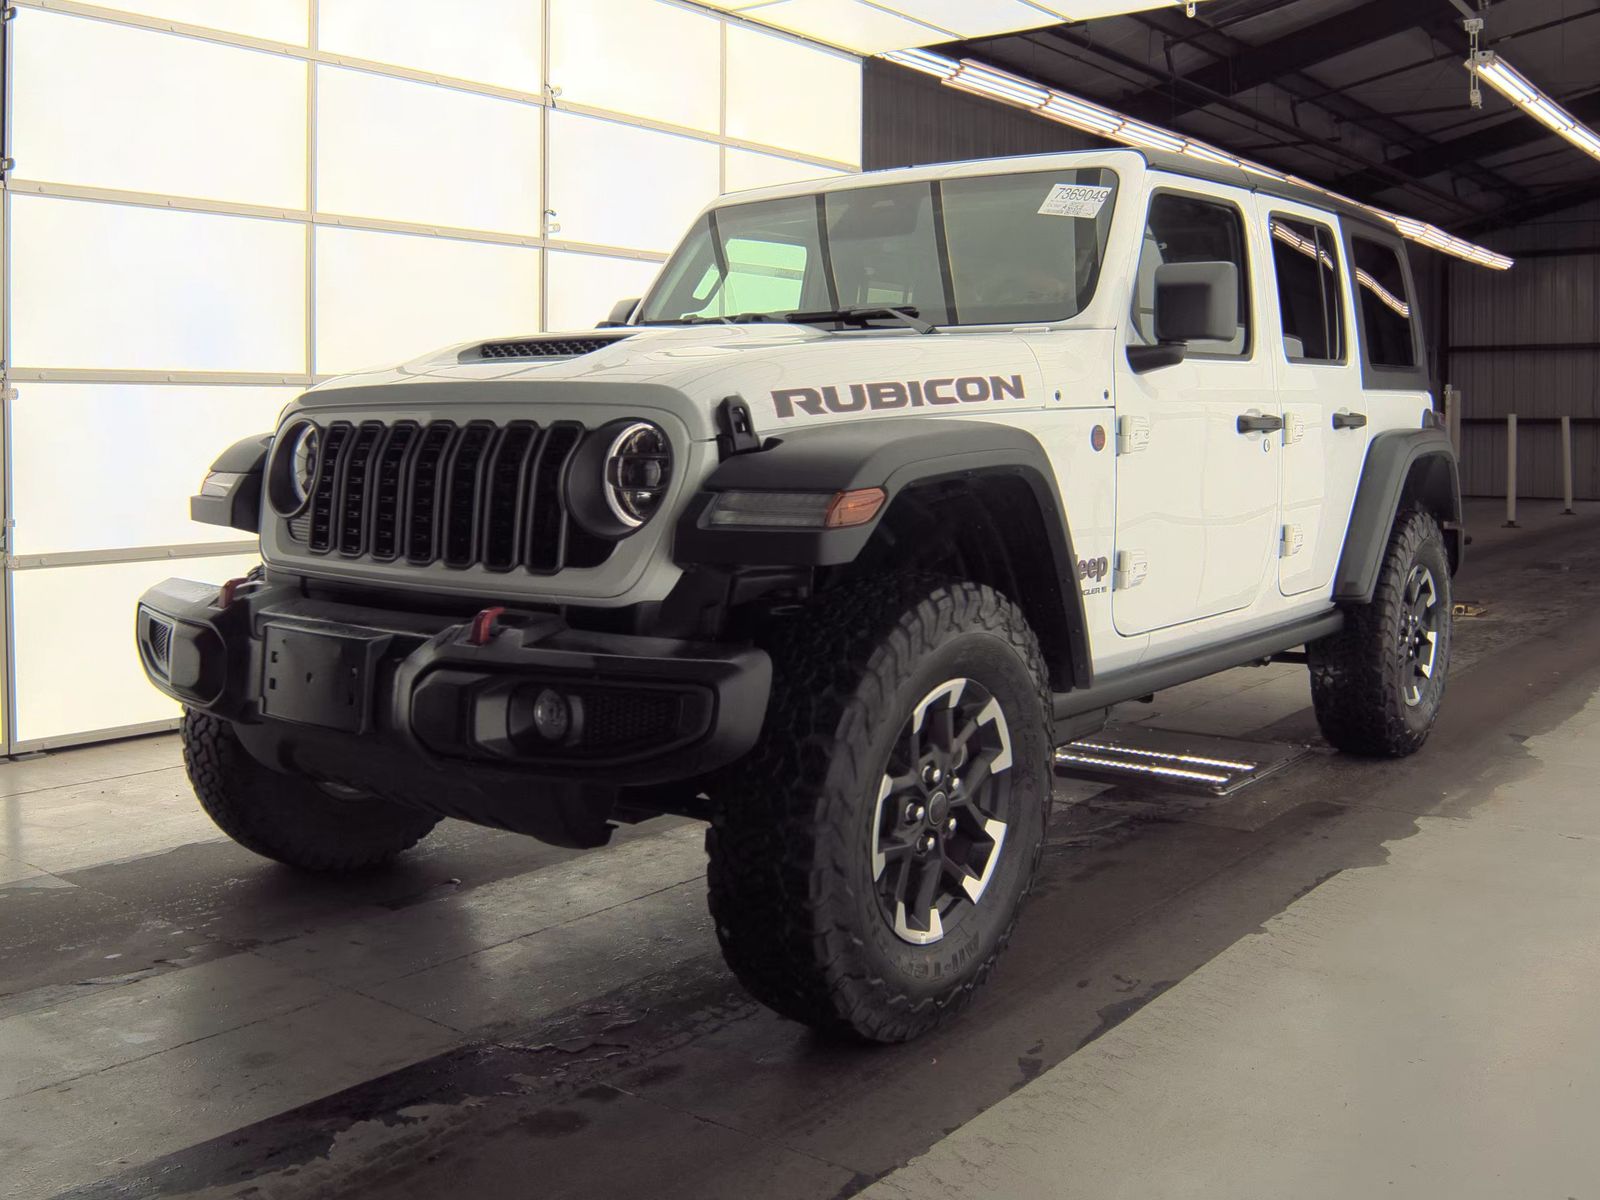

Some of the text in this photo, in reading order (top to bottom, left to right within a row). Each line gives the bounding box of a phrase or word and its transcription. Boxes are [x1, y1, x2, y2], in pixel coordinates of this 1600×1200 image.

[1055, 187, 1109, 203] 7369049
[771, 374, 1026, 418] RUBICON
[1075, 556, 1108, 582] eep
